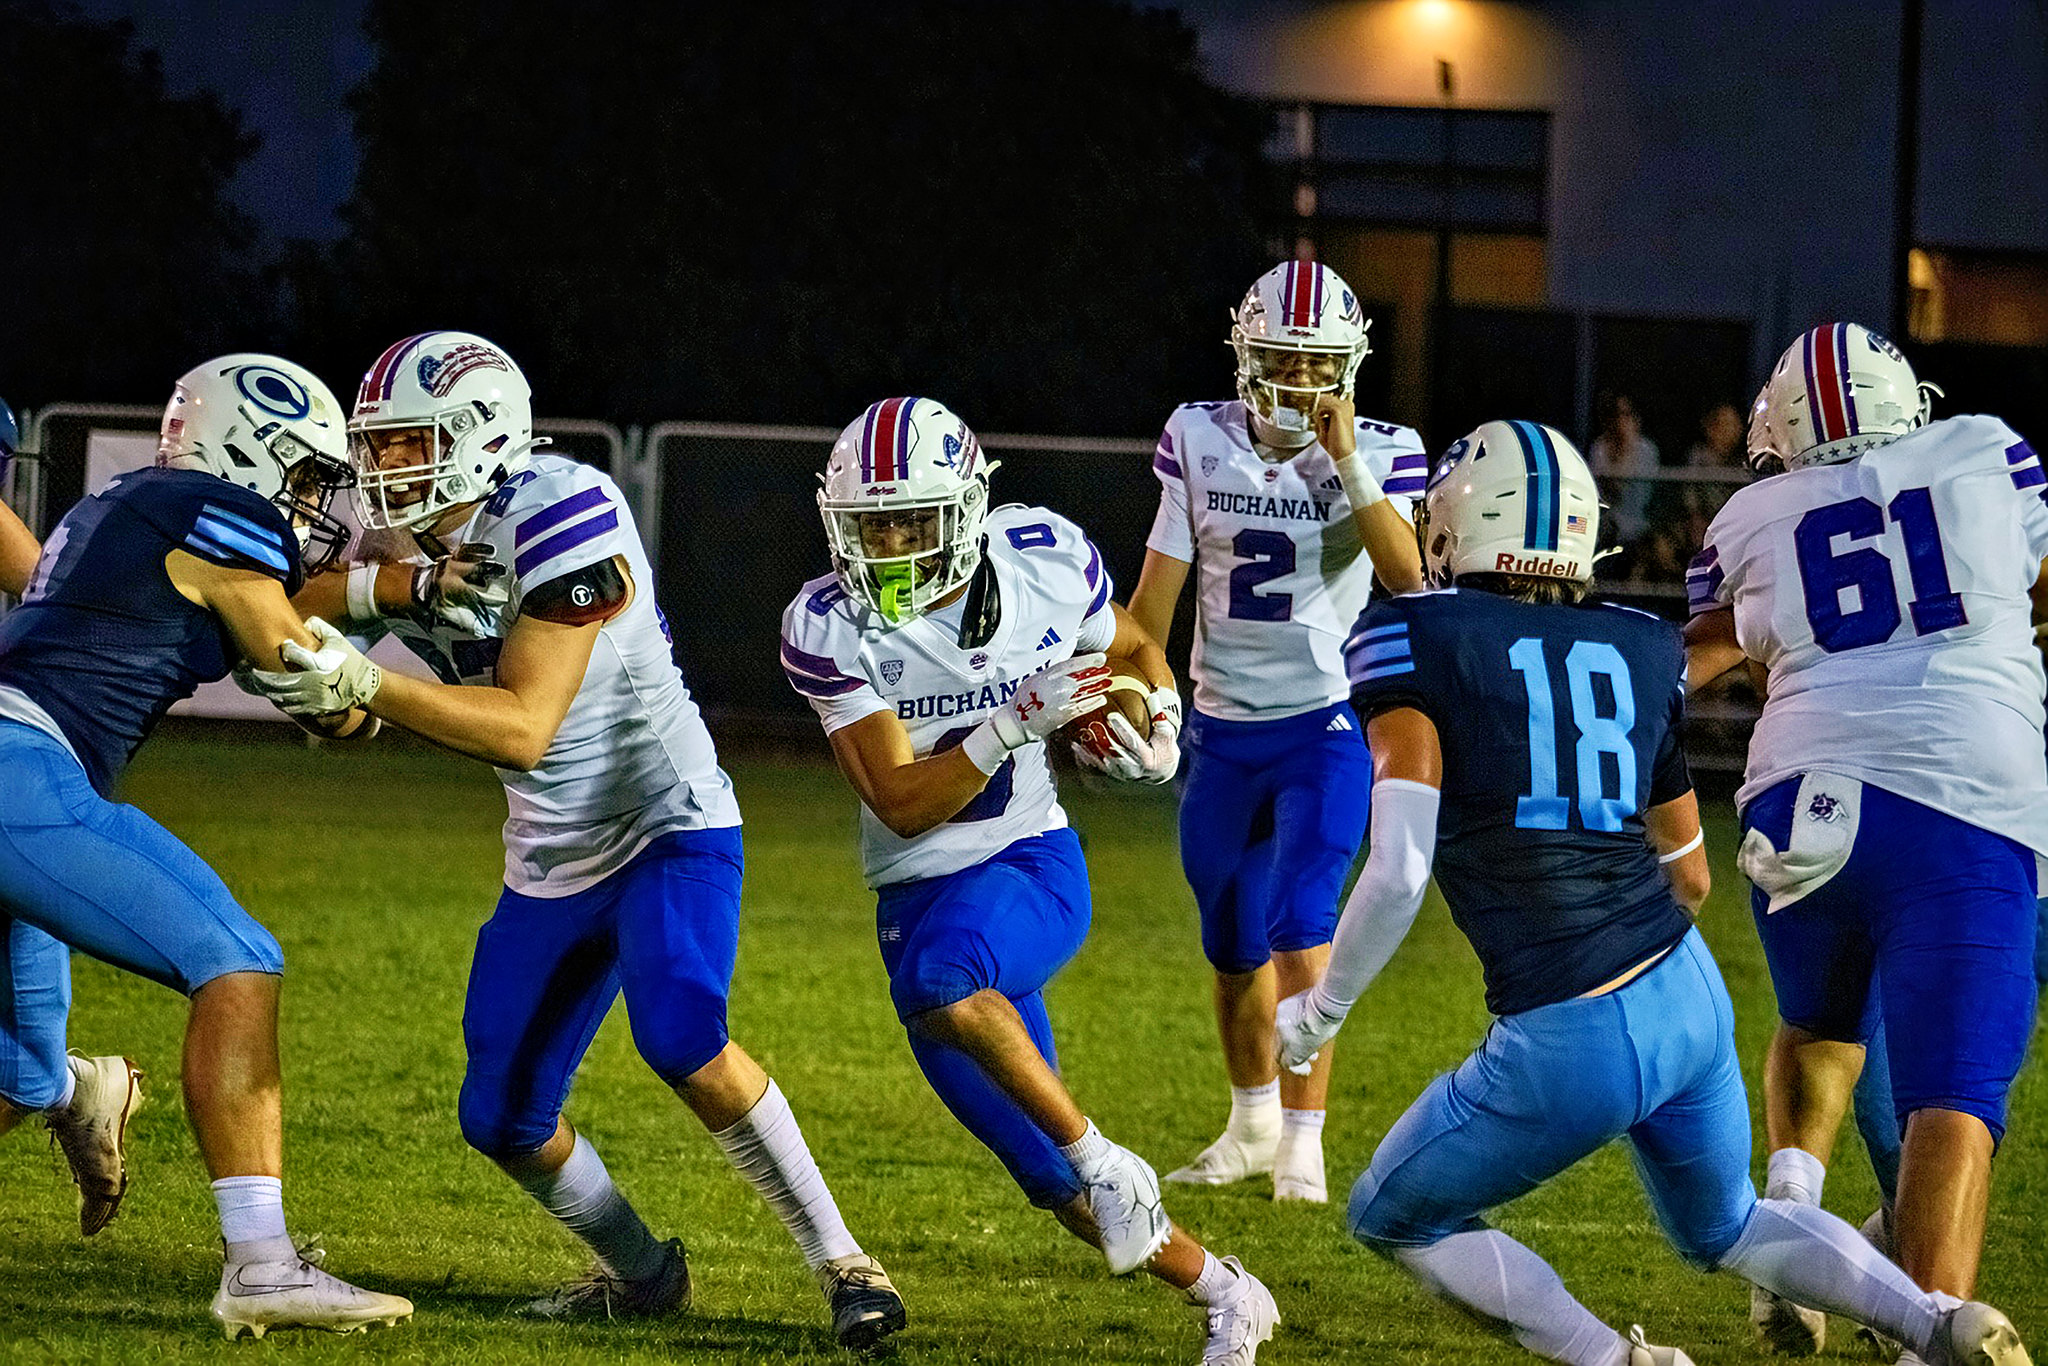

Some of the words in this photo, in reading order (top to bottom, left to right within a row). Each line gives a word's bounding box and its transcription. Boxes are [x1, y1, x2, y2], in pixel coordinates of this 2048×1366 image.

[1206, 490, 1332, 522] BUCHANAN
[1228, 528, 1297, 622] 2
[1494, 552, 1578, 578] Riddell
[1793, 486, 1970, 654] 61
[897, 659, 1052, 721] BUCHAN
[1508, 637, 1637, 832] 18
